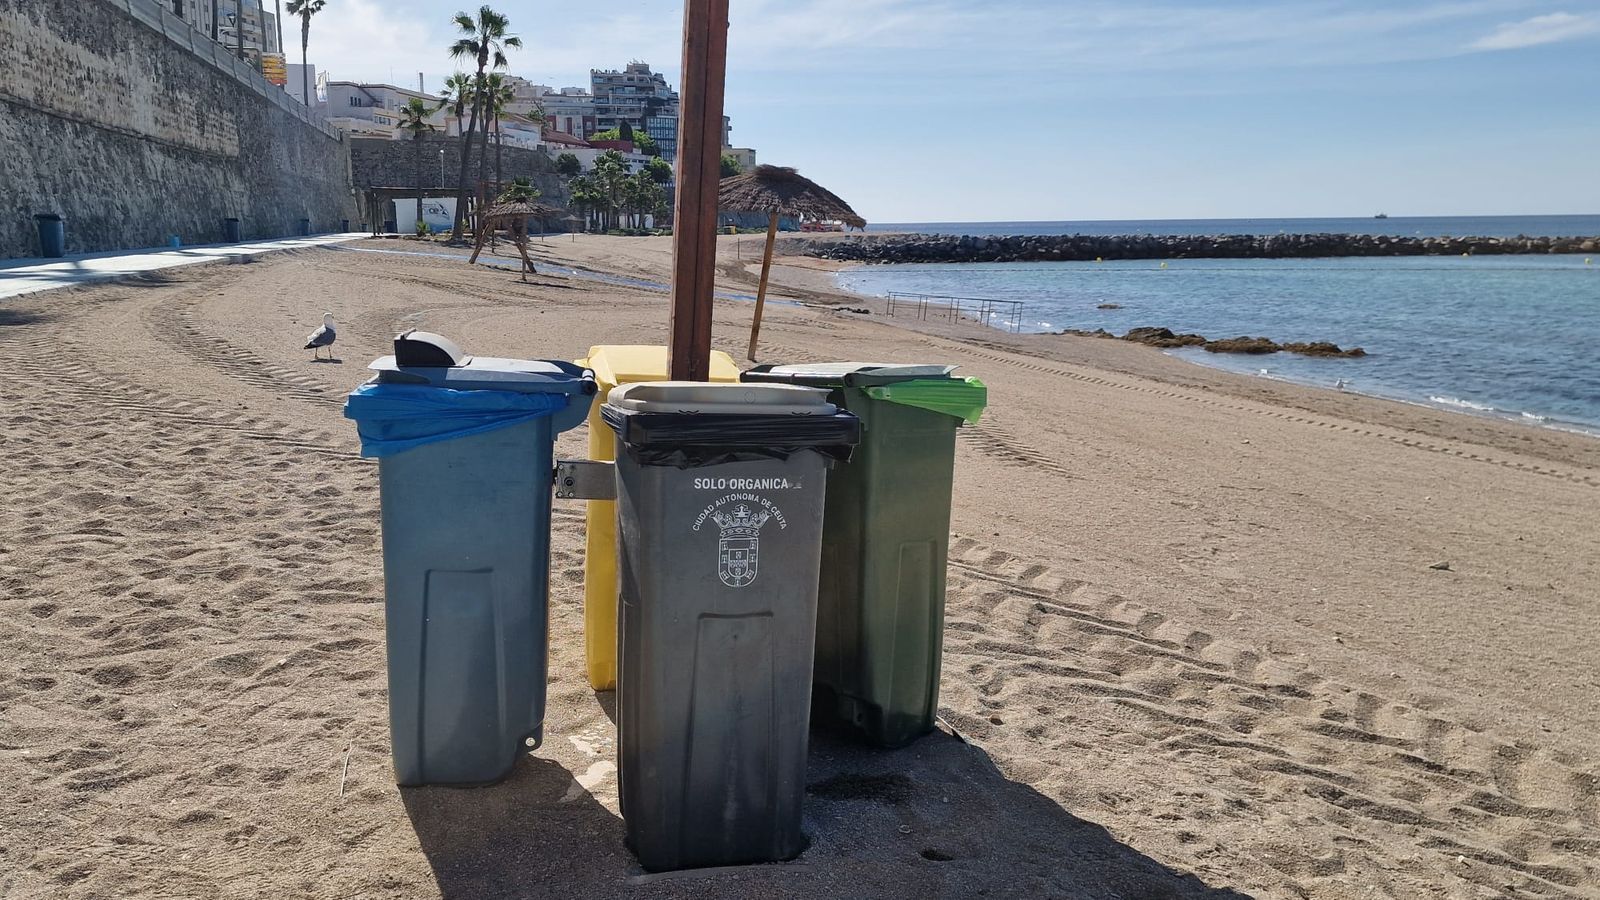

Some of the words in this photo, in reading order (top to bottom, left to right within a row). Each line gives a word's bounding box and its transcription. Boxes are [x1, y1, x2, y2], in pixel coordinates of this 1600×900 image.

[694, 478, 726, 490] SOLO
[729, 478, 789, 490] ORGANICA
[692, 504, 715, 532] CIUDAD
[715, 493, 760, 507] AUTONOMA
[761, 498, 772, 509] DE
[770, 506, 788, 530] CEUTA
